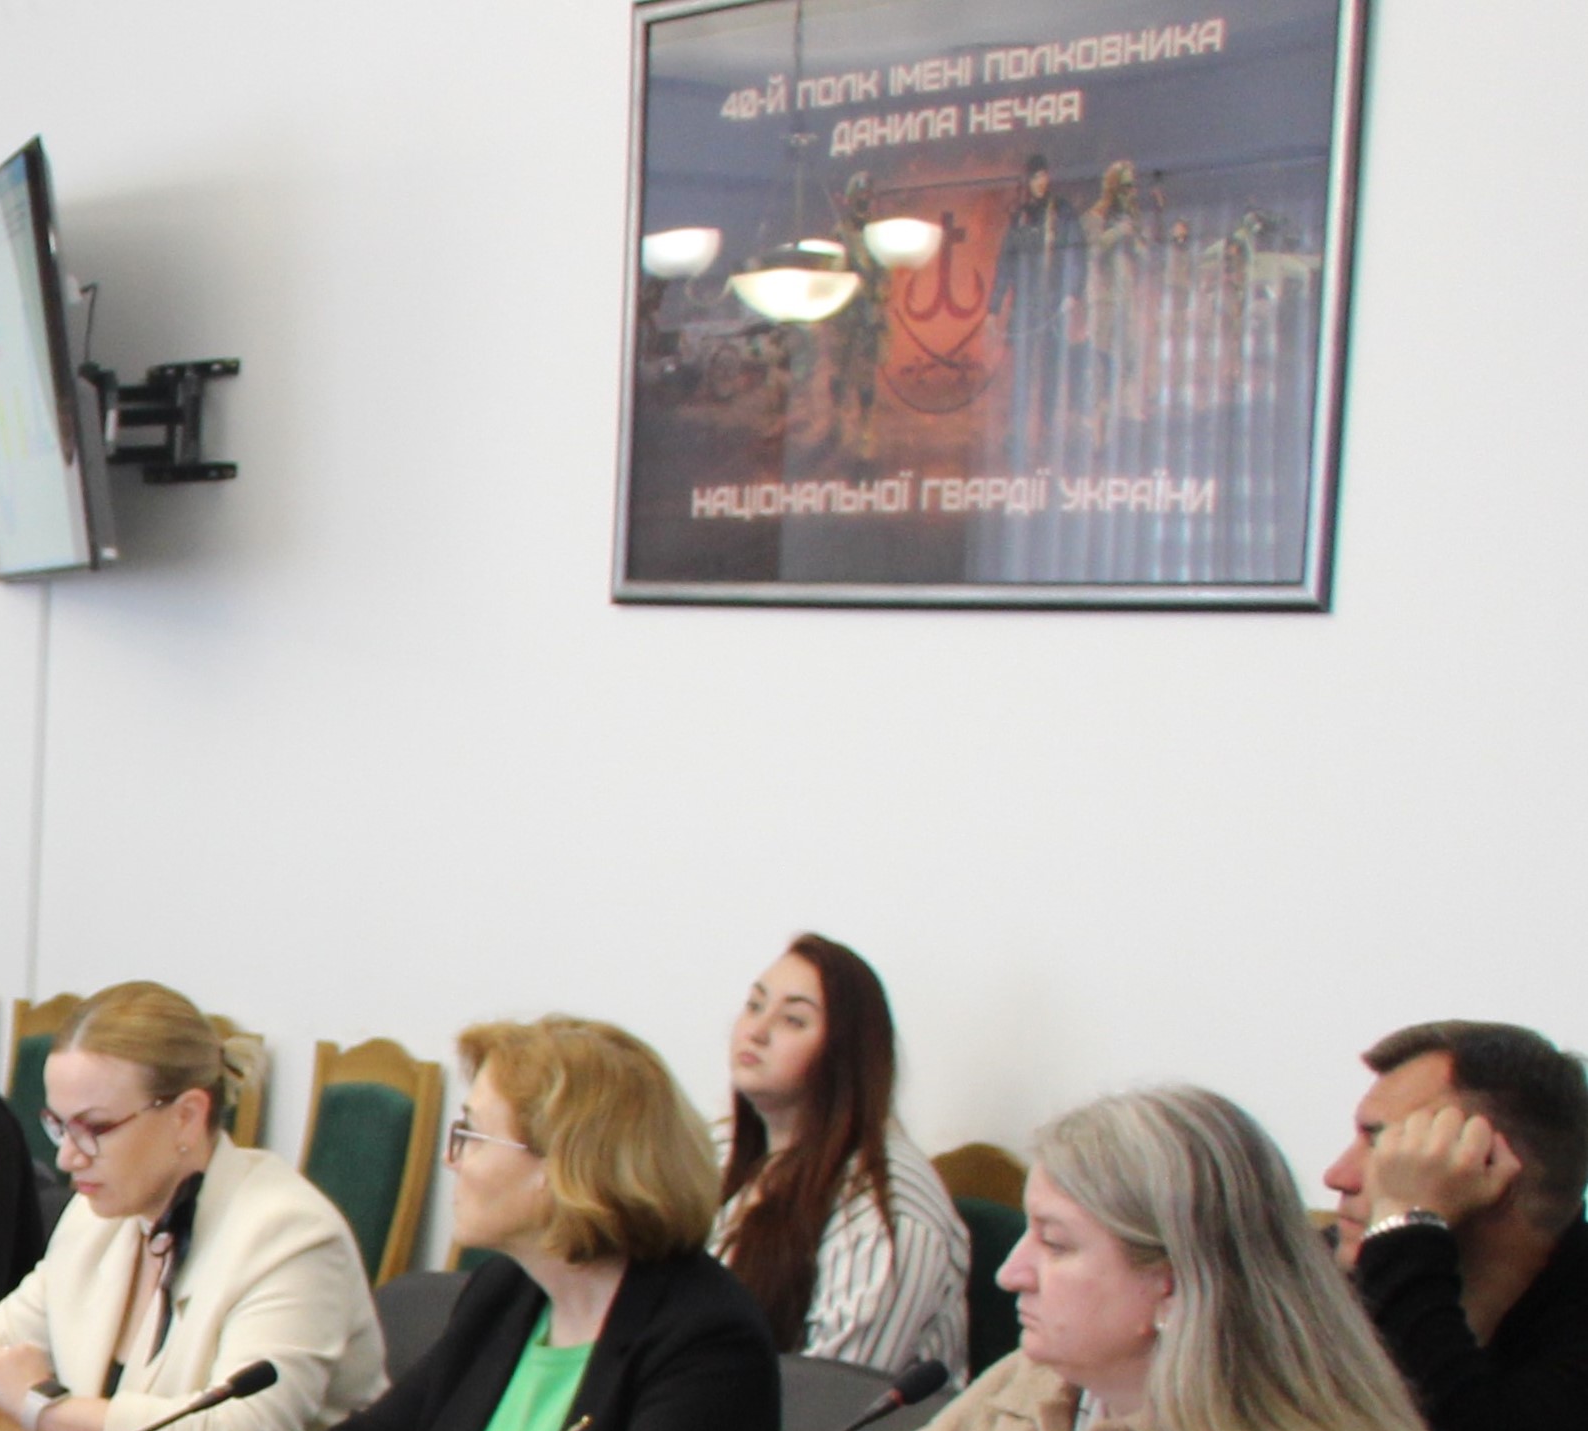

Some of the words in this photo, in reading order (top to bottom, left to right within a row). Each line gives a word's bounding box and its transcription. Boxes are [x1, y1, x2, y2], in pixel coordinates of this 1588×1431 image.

[720, 74, 789, 120] 40-Й
[796, 70, 881, 110] ПОЛК
[888, 55, 973, 97] ІМЕНІ
[983, 18, 1225, 84] ПОЛКОВНИКА
[829, 105, 960, 158] ДАНИЛА
[968, 90, 1083, 134] НЕЧАЯ
[691, 469, 914, 521] НАЦІОНАЛЬНОЇ
[921, 467, 1052, 516] ГВАРДІЇ
[1059, 467, 1218, 514] УКРАЇНИ
